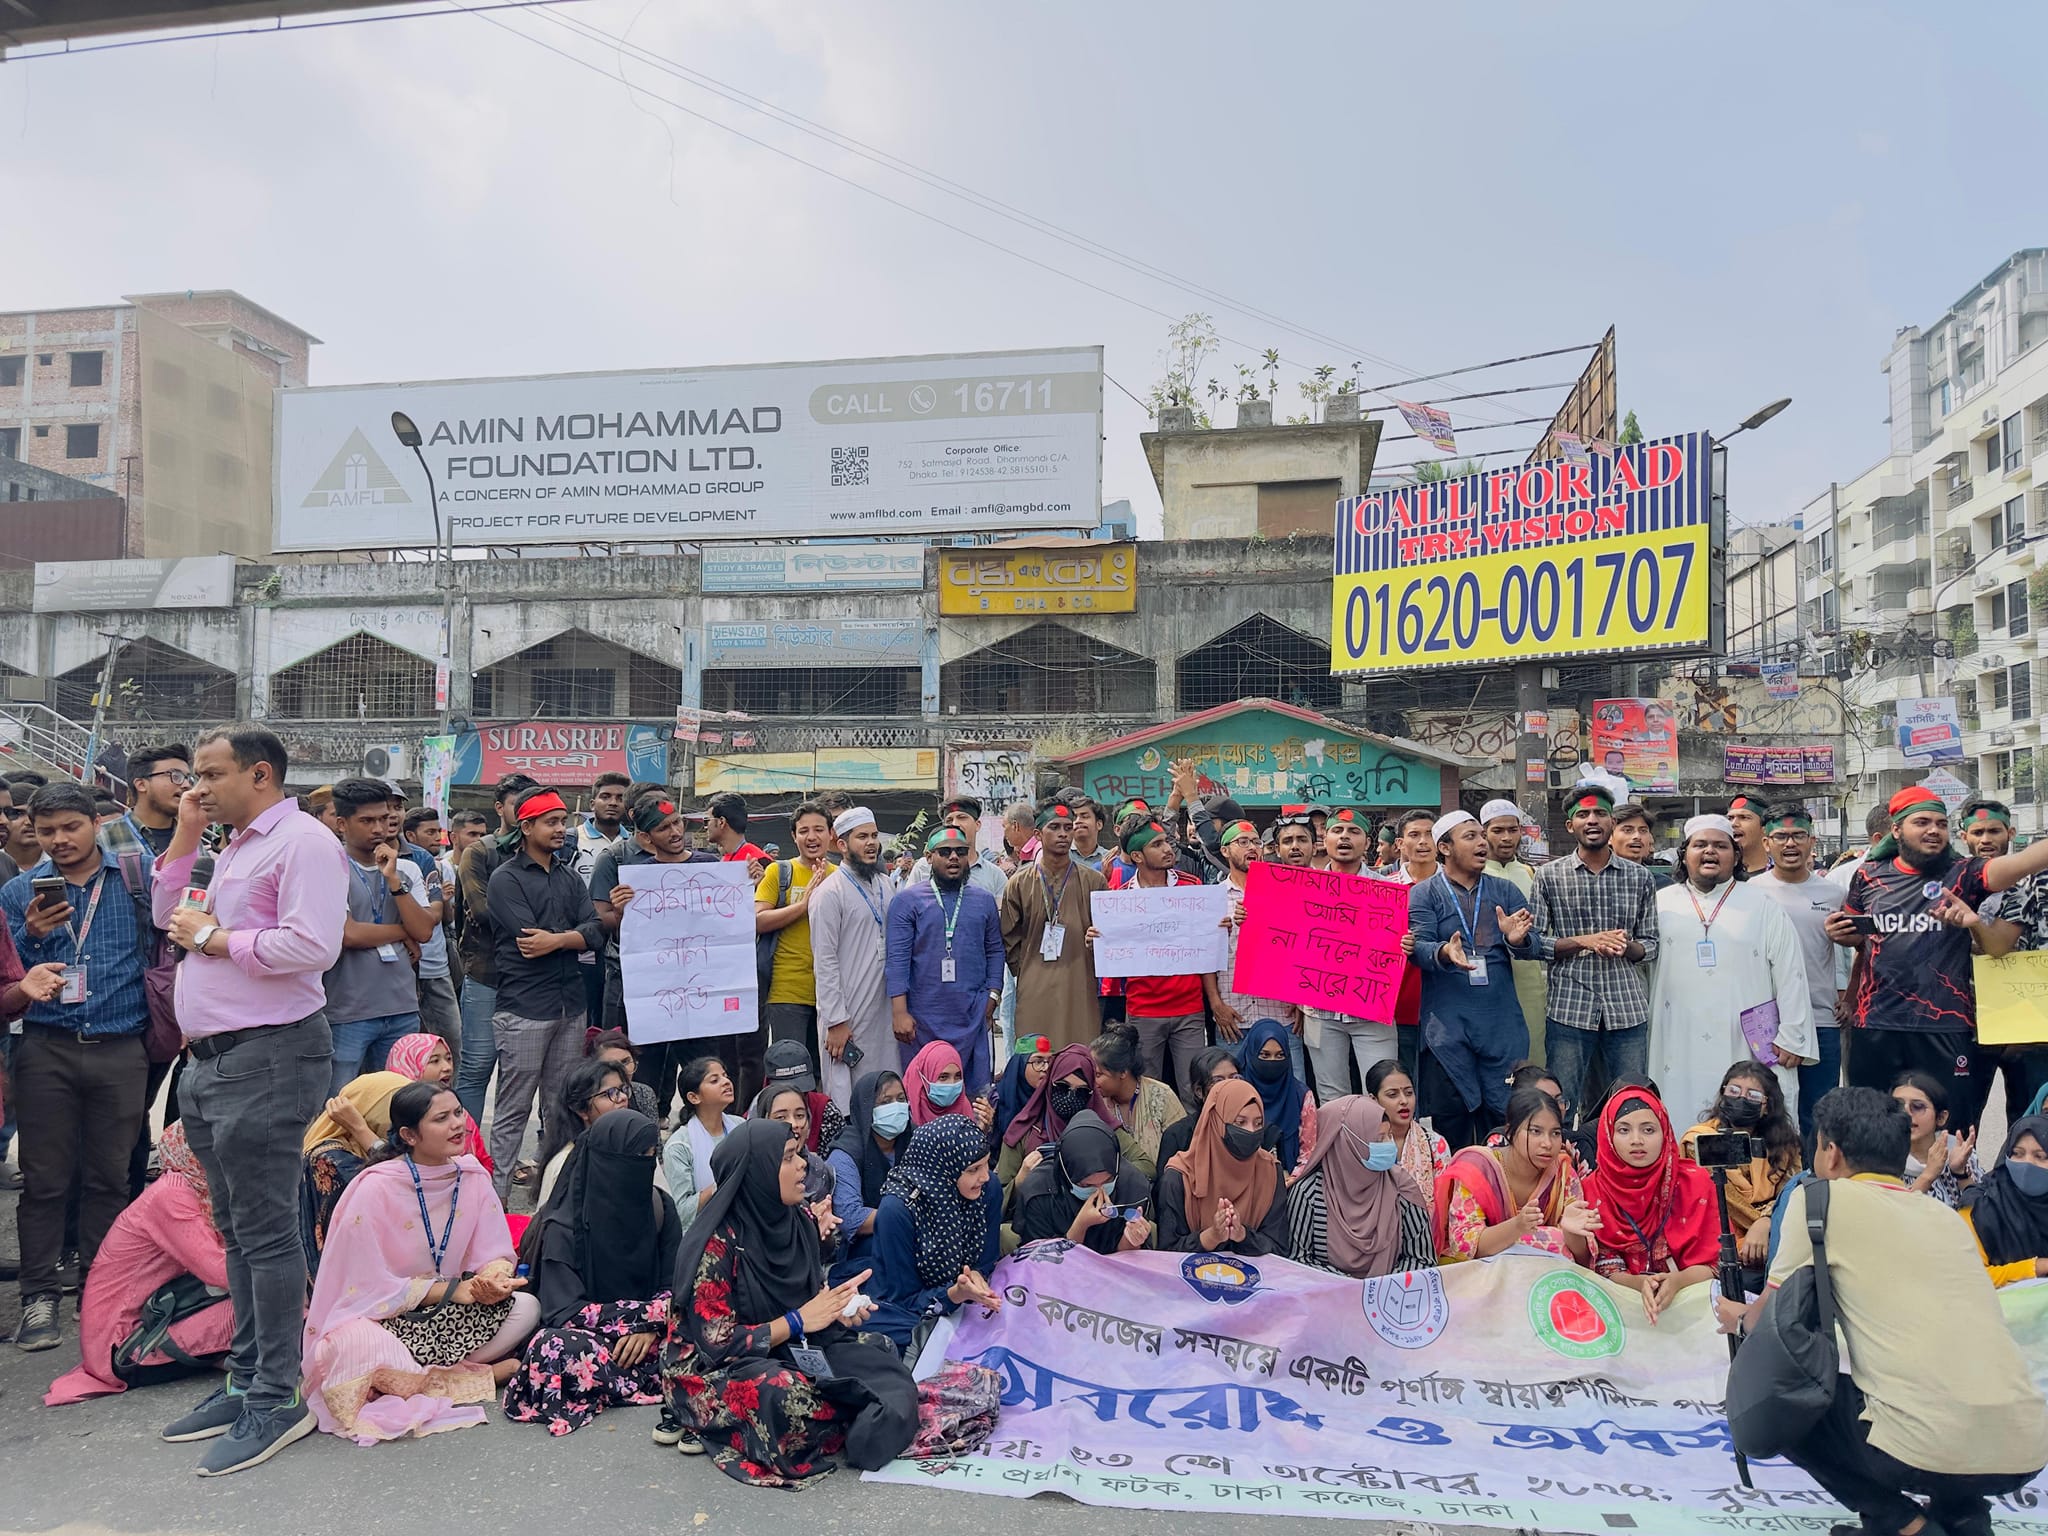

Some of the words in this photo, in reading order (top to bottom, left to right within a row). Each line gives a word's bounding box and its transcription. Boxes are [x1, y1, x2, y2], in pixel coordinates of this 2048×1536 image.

[827, 393, 892, 416] CALL
[954, 379, 1051, 413] 16711
[429, 416, 524, 446] AMIN
[536, 406, 782, 441] MOHAMMAD
[447, 448, 677, 479] FOUNDATION
[688, 446, 762, 472] LTD.
[945, 445, 988, 457] Corporate
[329, 490, 383, 506] AMFL
[439, 491, 450, 502] A
[453, 487, 530, 502] CONCERN
[535, 486, 557, 500] OF
[561, 485, 600, 499] AMIN
[604, 482, 701, 497] MOHAMMAD
[705, 480, 764, 494] GROUP
[1354, 480, 1477, 537] CALL
[1485, 462, 1595, 516] FOR
[1605, 444, 1684, 496] AD
[453, 515, 523, 528] PROJECT
[527, 514, 560, 526] FOR
[564, 512, 628, 525] FUTURE
[633, 509, 757, 524] DEVELOPMENT
[830, 508, 922, 520] www.amflbd.com
[931, 505, 961, 517] Email
[971, 502, 1071, 516] amfl@amgbd.com
[1398, 503, 1628, 562] TRY-VISION
[706, 549, 784, 562] NEWSTAR
[1344, 542, 1695, 659] 01620-001707
[714, 626, 766, 638] NEWSTAR
[742, 638, 766, 647] TRAVELS
[488, 727, 622, 751] SURASREE
[502, 752, 605, 771] সুরশ্রী
[1725, 759, 1763, 771] Luminous
[1269, 864, 1341, 897] আমার
[1304, 901, 1361, 926] আমি
[654, 934, 715, 968] লাল
[1268, 927, 1299, 950] না
[1307, 927, 1361, 964] দিলে
[1293, 964, 1348, 998] মরে
[1035, 1292, 1166, 1356] কলেজের
[1289, 1356, 1370, 1396] একটি
[1380, 1370, 1465, 1407] পূর্ণাঙ্গ
[1366, 1416, 1453, 1446] ও
[1098, 1474, 1193, 1501] ফটক,
[1210, 1483, 1283, 1502] ঢাকা
[1436, 1501, 1521, 1520] ঢাকা
